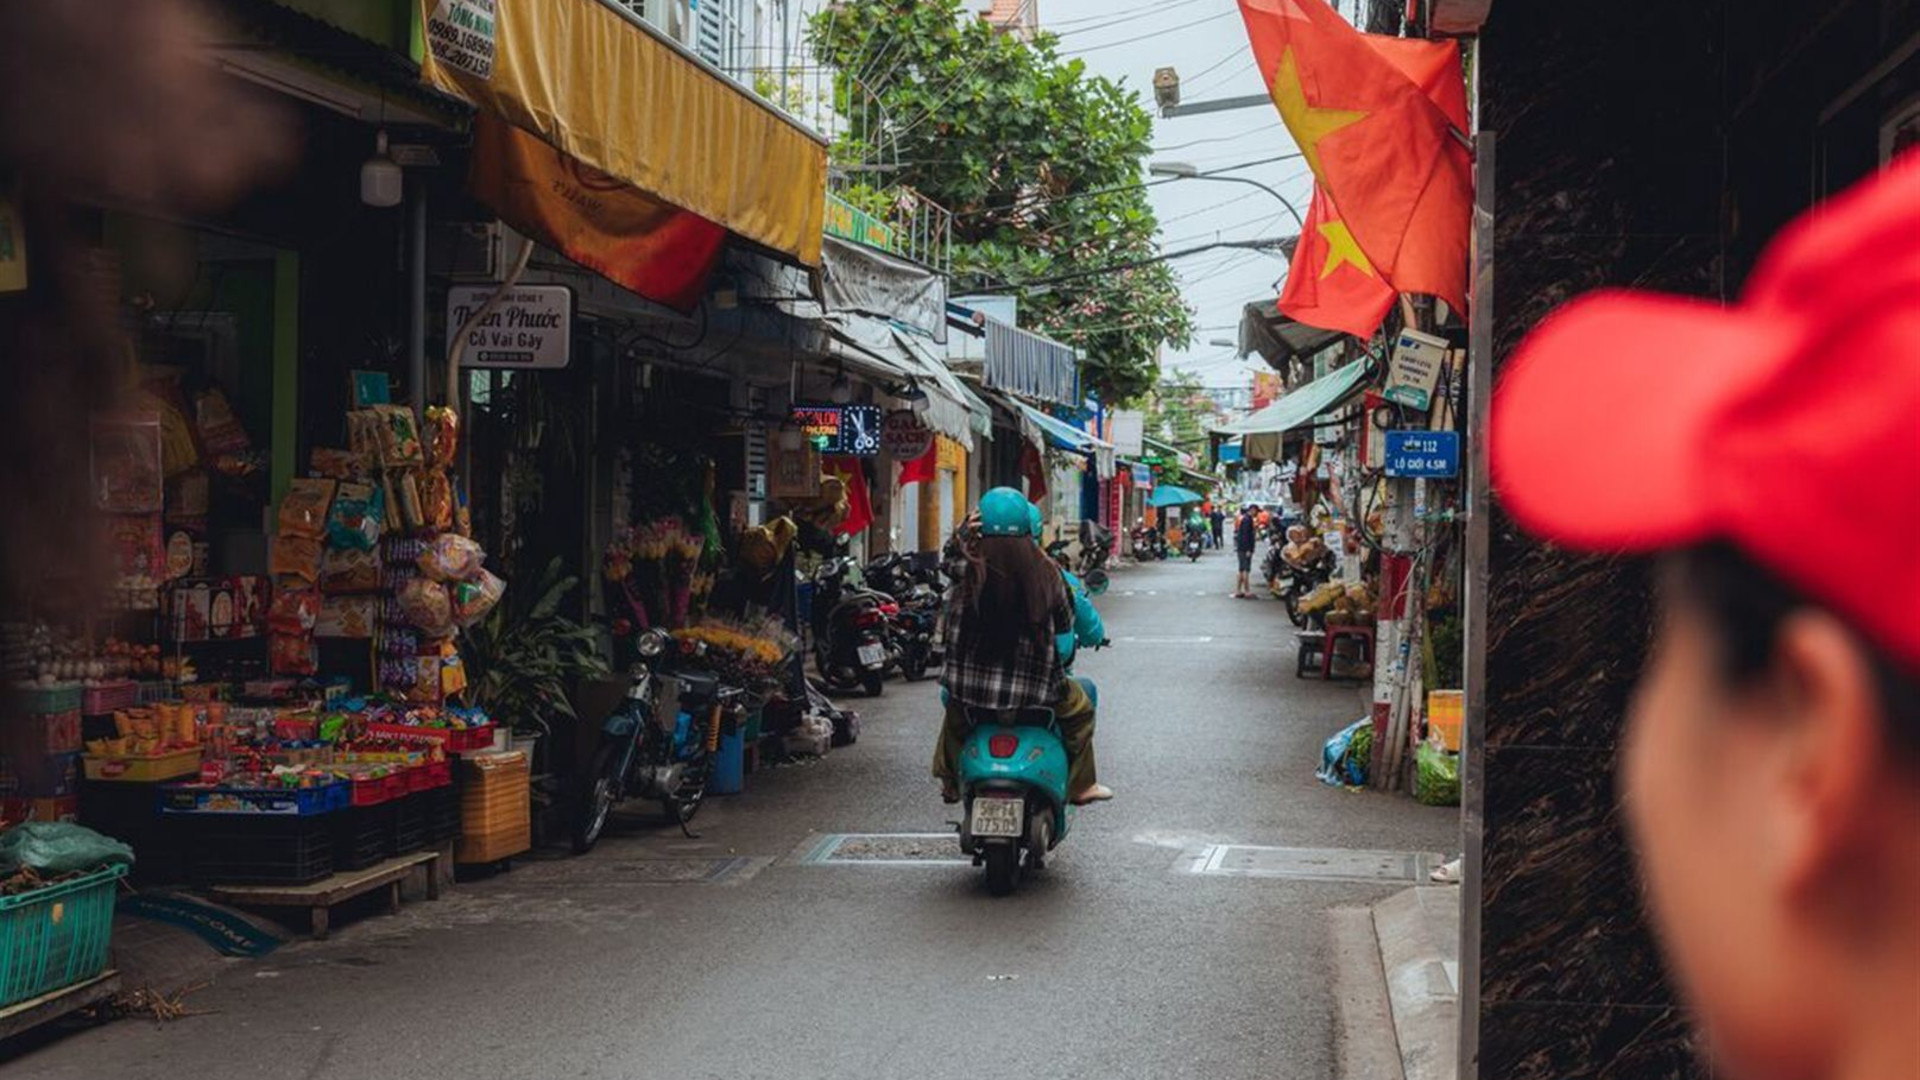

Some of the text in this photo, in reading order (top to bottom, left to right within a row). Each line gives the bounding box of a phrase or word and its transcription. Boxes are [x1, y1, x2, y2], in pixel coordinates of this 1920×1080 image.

[506, 305, 562, 329] Phước
[469, 329, 487, 347] Cổ
[491, 332, 513, 347] Vai
[1422, 439, 1438, 453] 112
